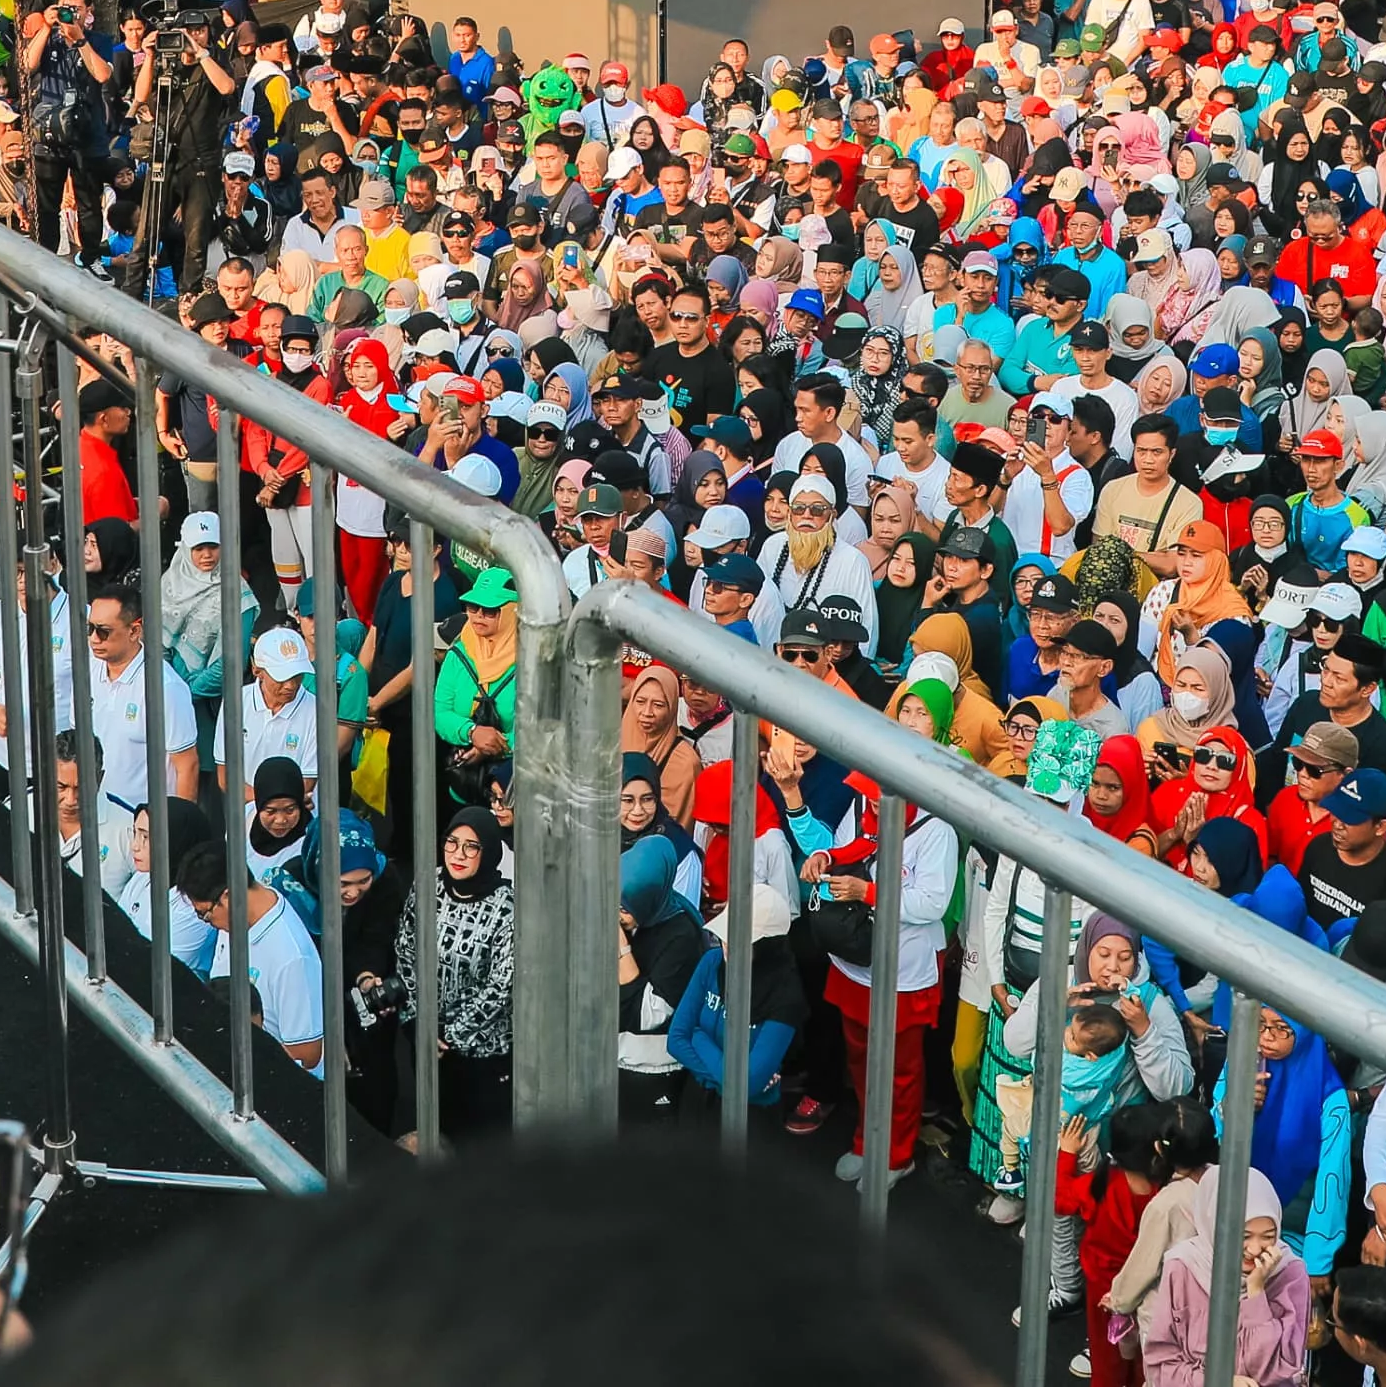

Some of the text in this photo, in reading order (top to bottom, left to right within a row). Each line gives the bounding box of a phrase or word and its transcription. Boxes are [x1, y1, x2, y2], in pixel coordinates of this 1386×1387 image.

[528, 403, 564, 418] SPORT
[640, 403, 668, 416] PORT
[1276, 587, 1309, 604] ORT
